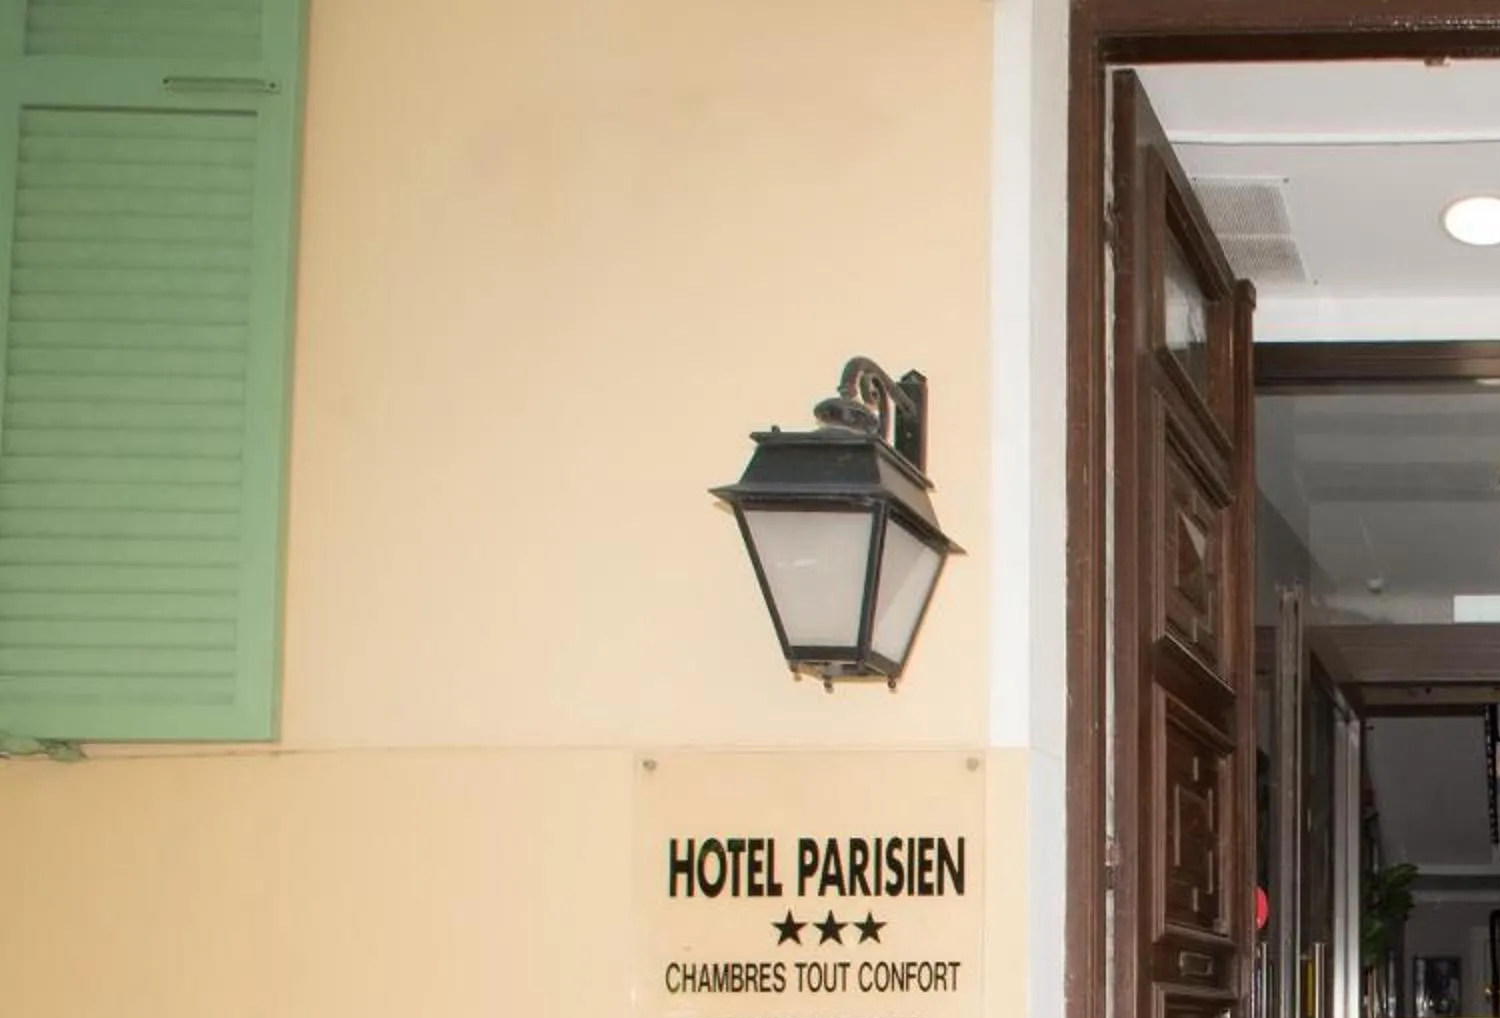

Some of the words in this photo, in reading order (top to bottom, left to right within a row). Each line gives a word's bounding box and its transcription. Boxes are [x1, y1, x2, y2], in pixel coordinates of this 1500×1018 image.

[669, 837, 783, 899] HOTEL
[797, 836, 965, 897] PARISIEN
[665, 961, 787, 994] CHAMBRES
[793, 961, 852, 994] TOUT
[857, 960, 961, 994] CONFORT
